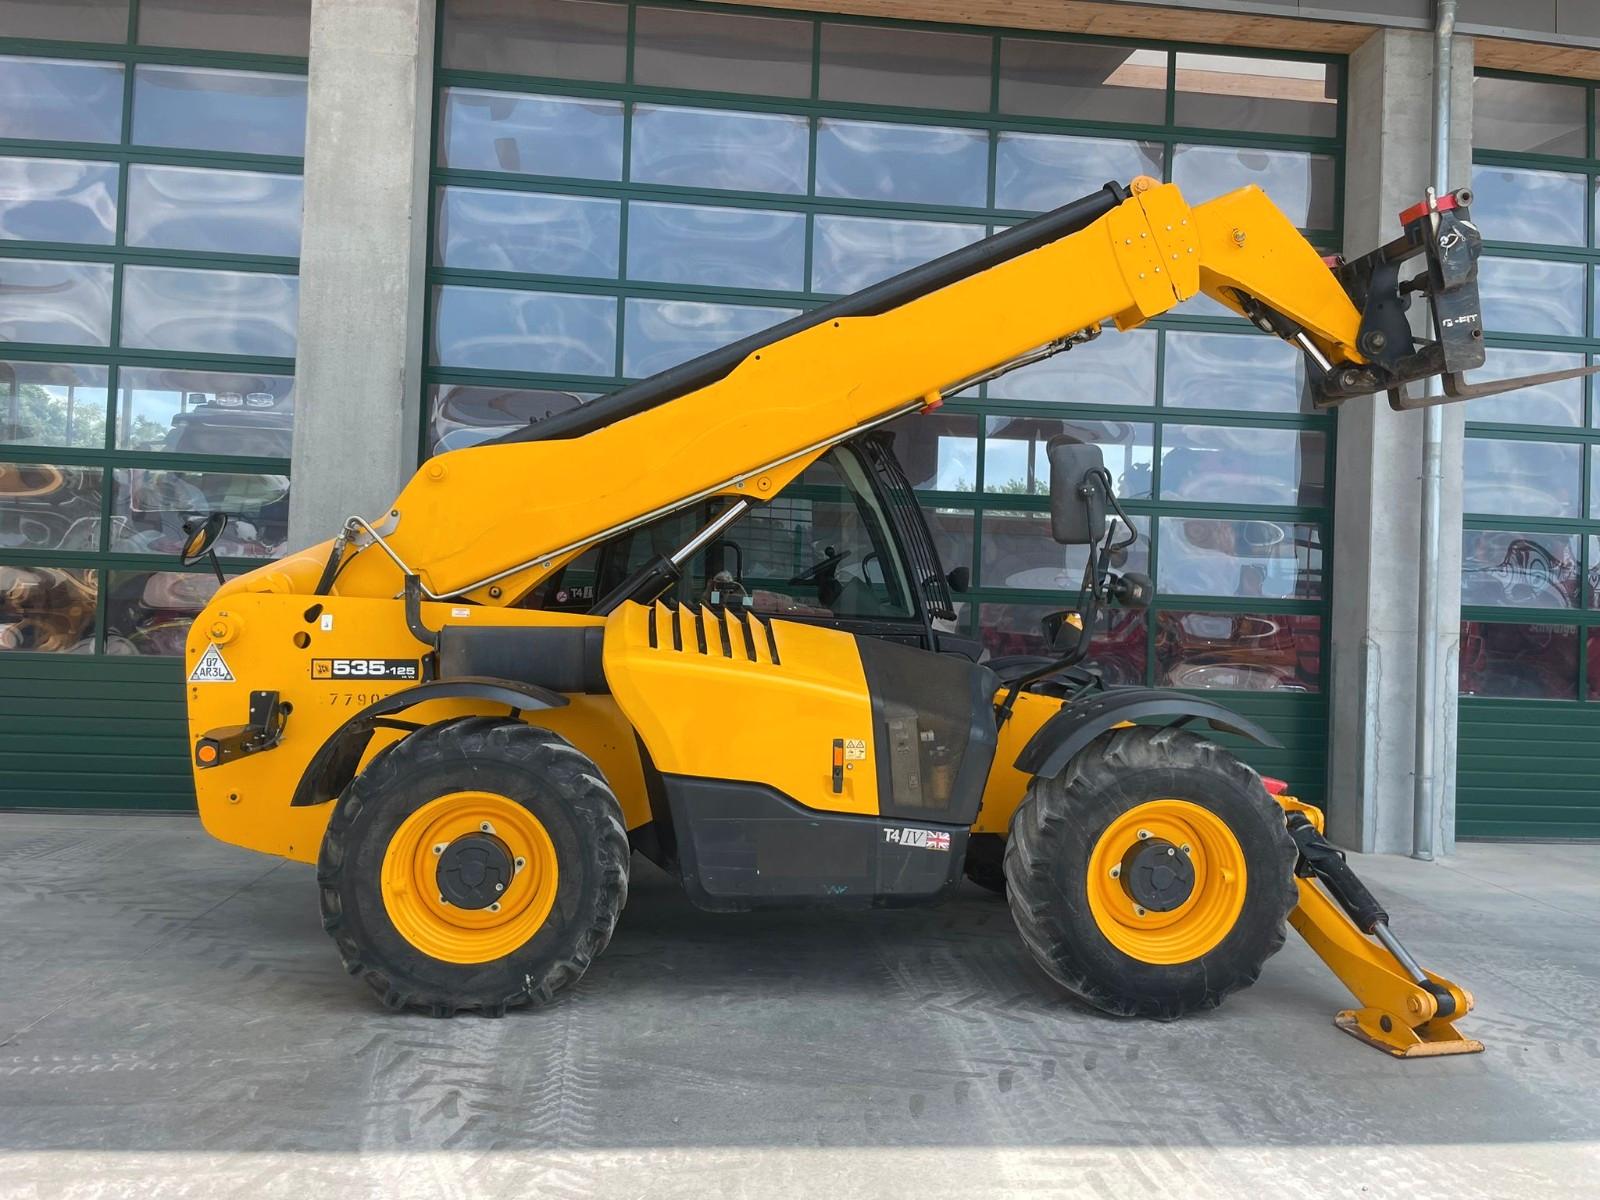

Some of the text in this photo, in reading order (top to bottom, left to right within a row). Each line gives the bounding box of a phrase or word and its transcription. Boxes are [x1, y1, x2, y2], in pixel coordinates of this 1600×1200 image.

[199, 667, 225, 678] AR3L
[333, 660, 416, 675] 535-125
[883, 828, 900, 843] T4
